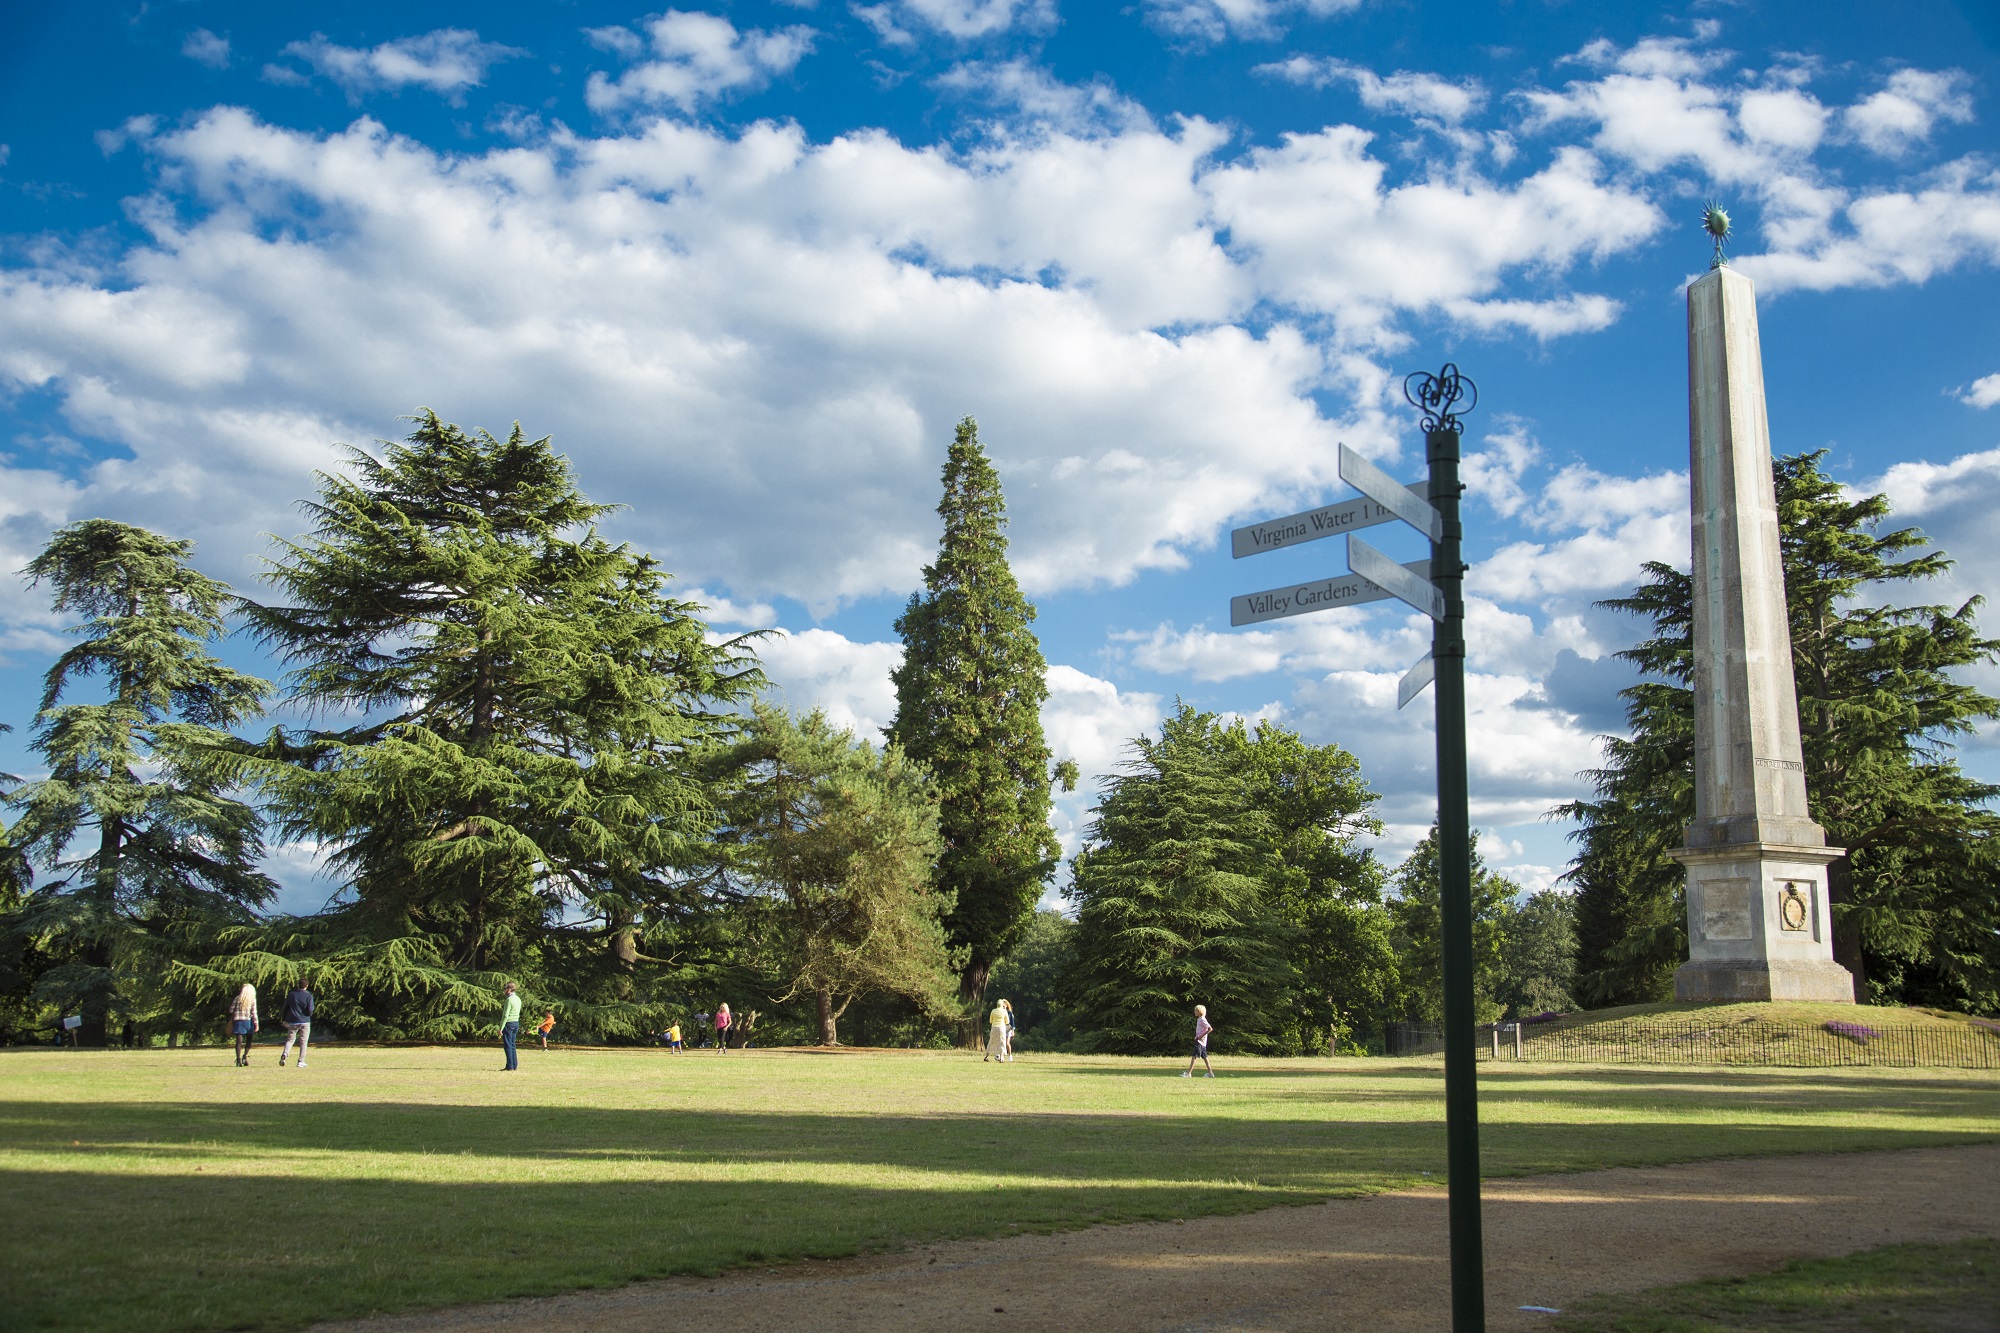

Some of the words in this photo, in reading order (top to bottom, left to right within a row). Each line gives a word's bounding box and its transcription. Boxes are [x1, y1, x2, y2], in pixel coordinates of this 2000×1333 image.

[1251, 523, 1306, 545] Virginia
[1310, 511, 1355, 531] Water
[1363, 504, 1369, 519] 1
[1248, 594, 1291, 614] Valley
[1295, 583, 1358, 606] Gardens
[1755, 759, 1800, 770] CUMBERLAND
